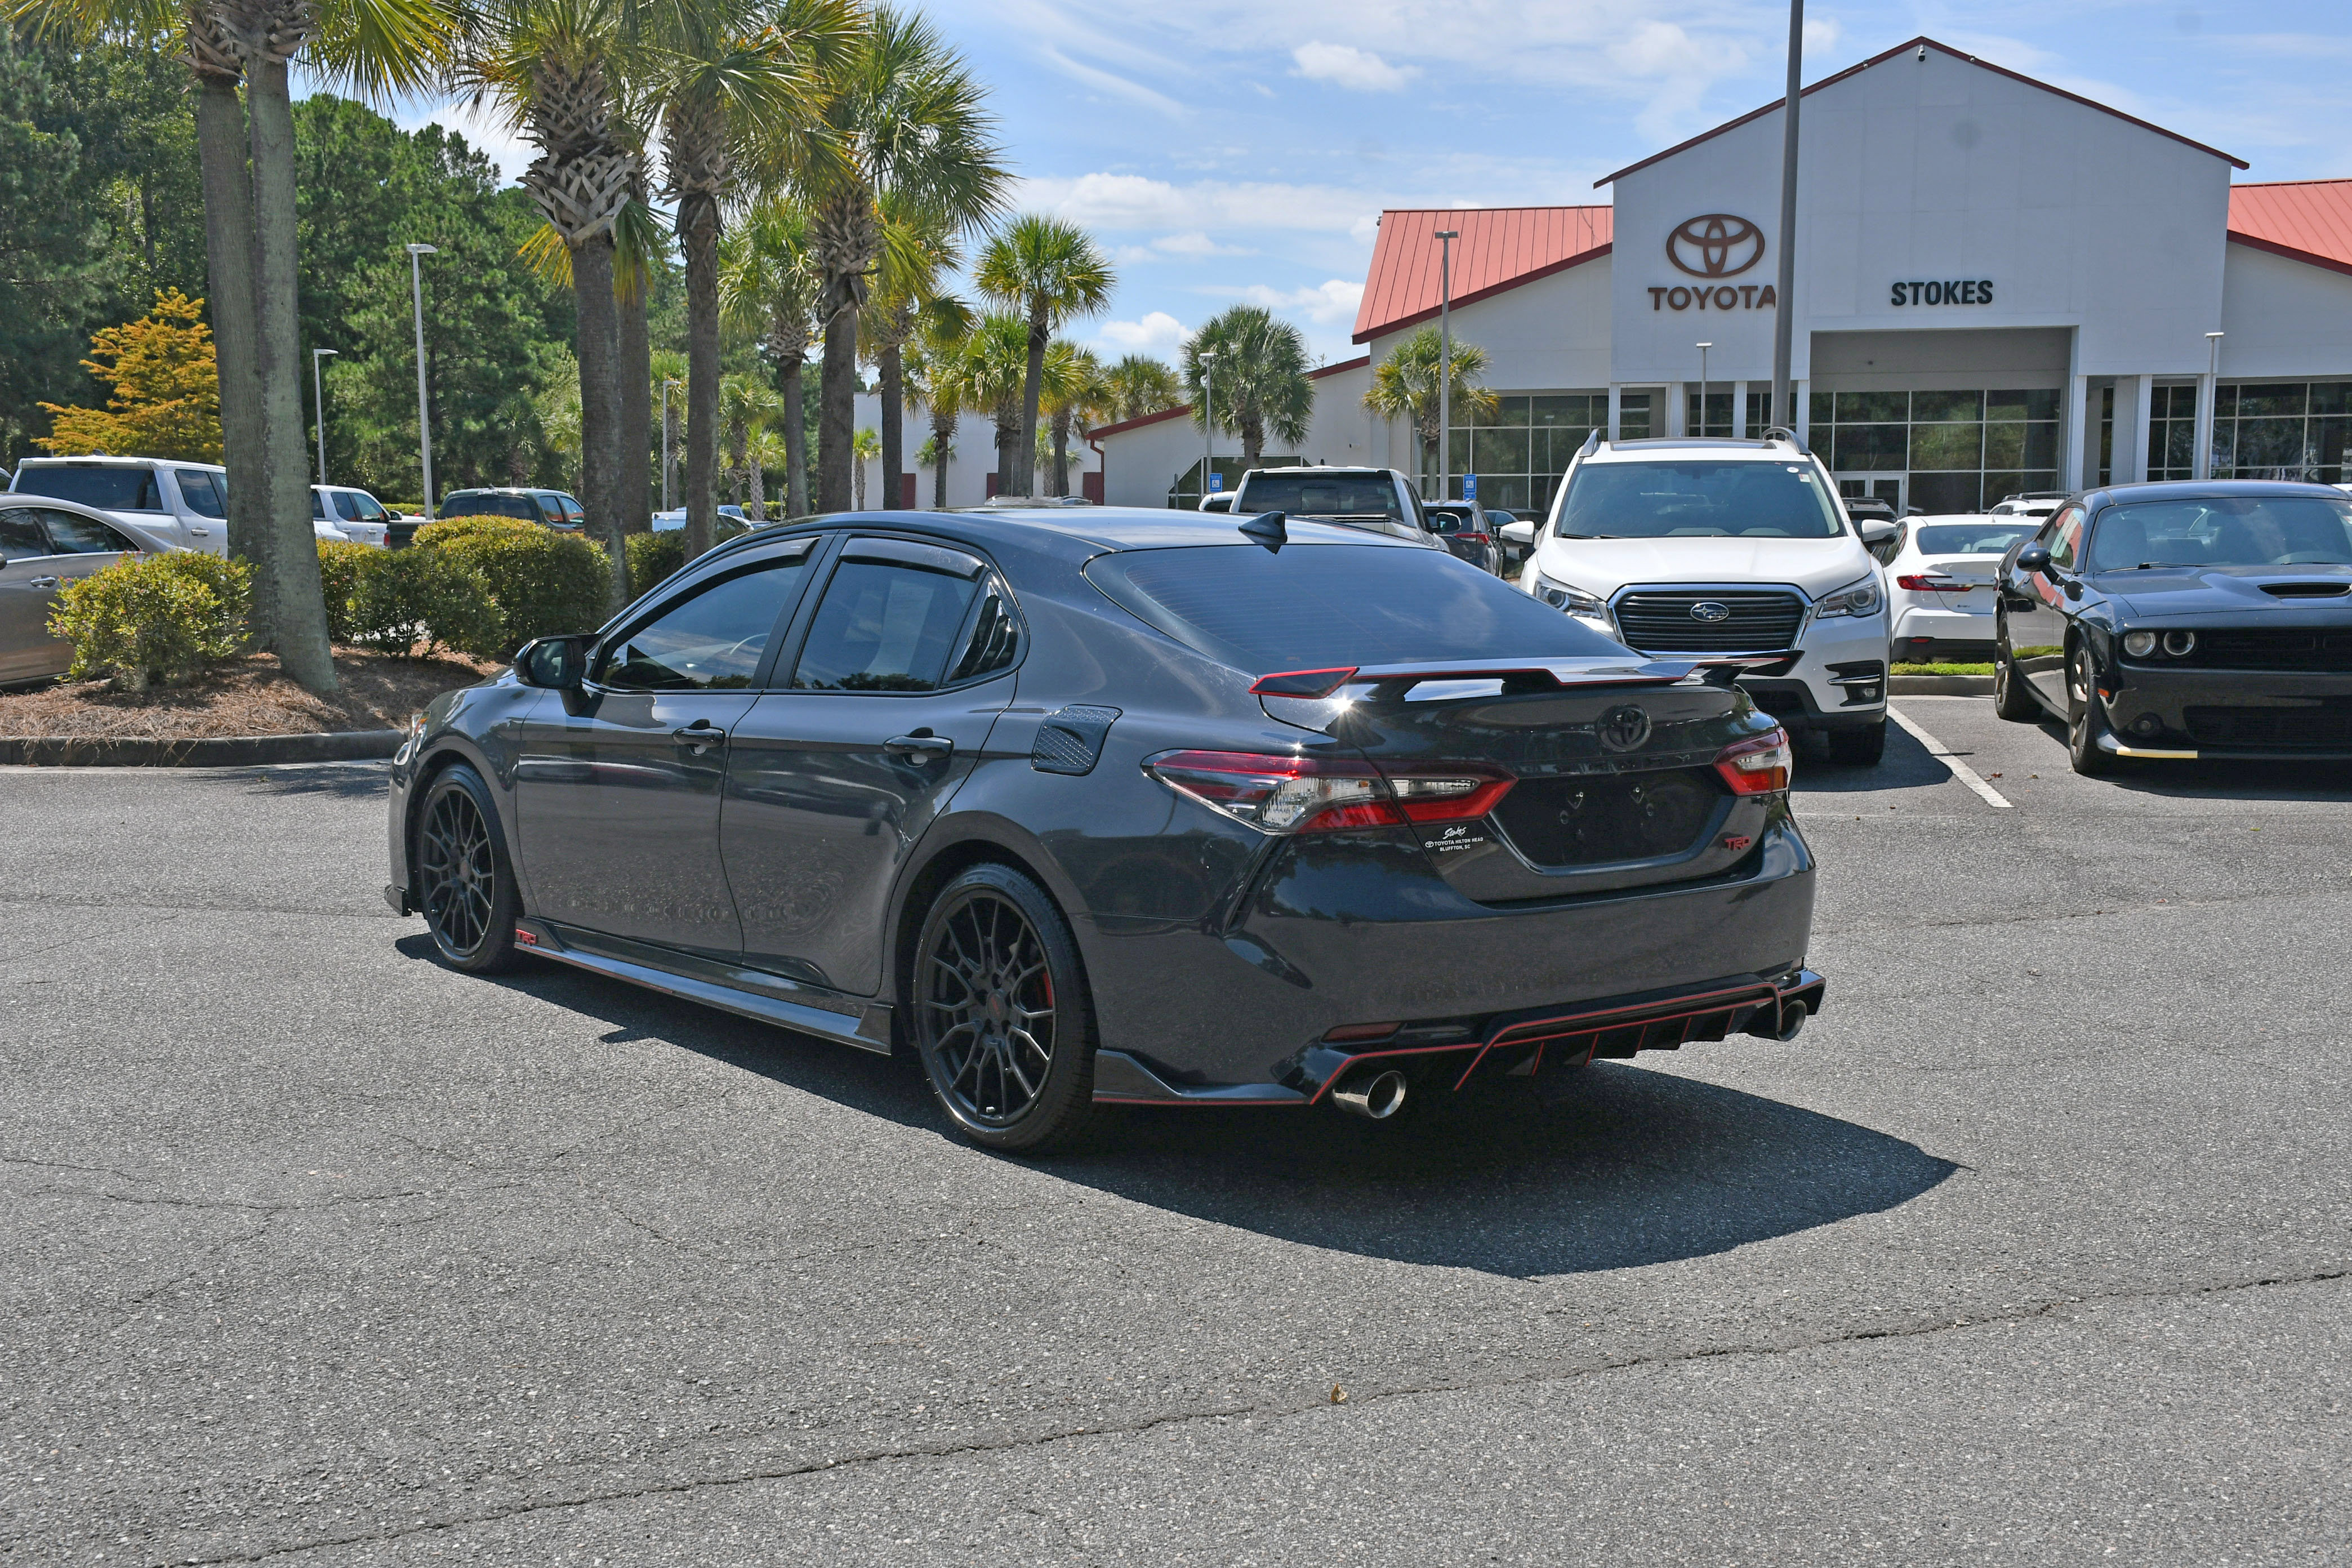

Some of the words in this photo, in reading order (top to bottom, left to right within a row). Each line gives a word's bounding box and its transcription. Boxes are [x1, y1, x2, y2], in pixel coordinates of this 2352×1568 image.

[1647, 285, 1776, 310] TOYOTA
[1891, 280, 1993, 306] STOKES
[1442, 826, 1467, 840] Stokes
[1724, 836, 1751, 850] TRD
[515, 929, 537, 945] TRD
